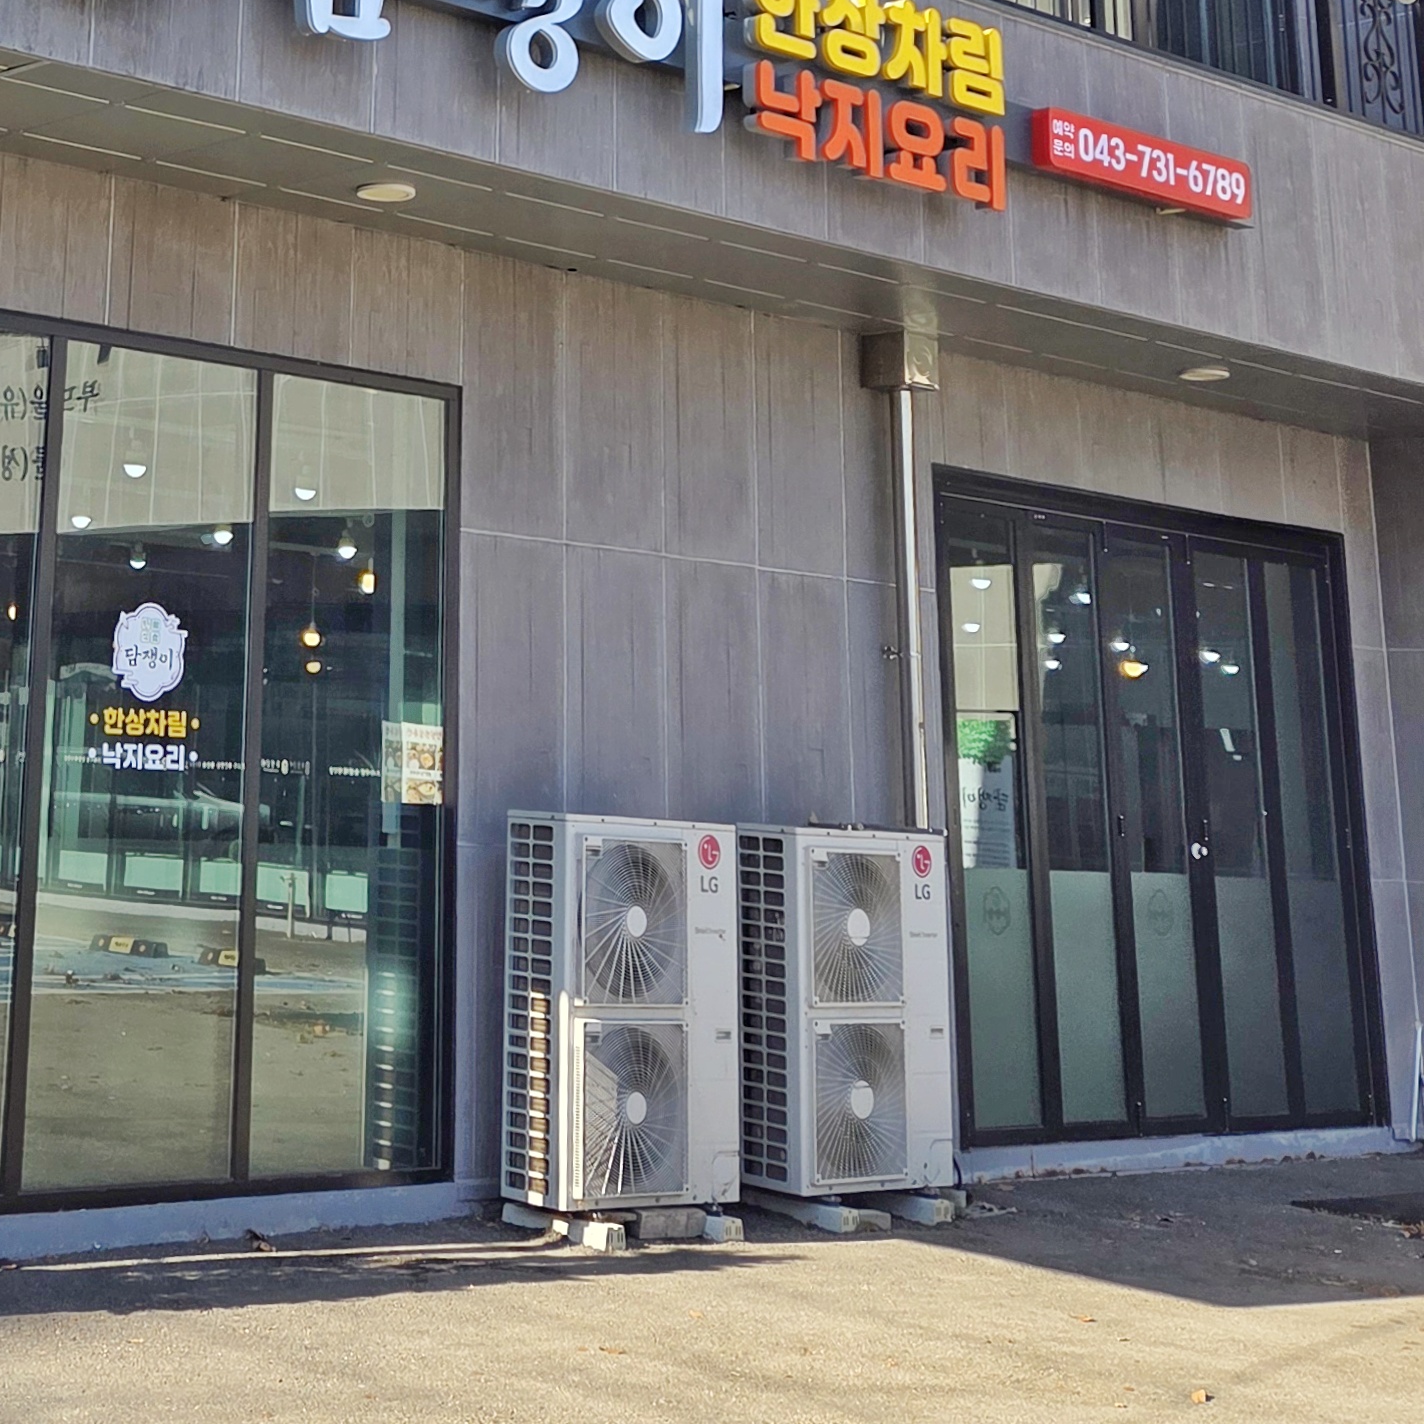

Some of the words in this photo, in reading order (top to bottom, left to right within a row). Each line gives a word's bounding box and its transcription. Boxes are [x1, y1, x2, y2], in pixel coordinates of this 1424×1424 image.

[744, 59, 1007, 212] 낙지요리
[1052, 119, 1075, 139] 예약
[1053, 139, 1075, 159] 문의
[1078, 128, 1245, 205] 043-731-6789
[124, 644, 173, 670] 담쟁이
[103, 707, 187, 738] 한상차림
[102, 742, 185, 771] 낙지요리
[700, 875, 719, 893] LG
[915, 883, 931, 900] LG
